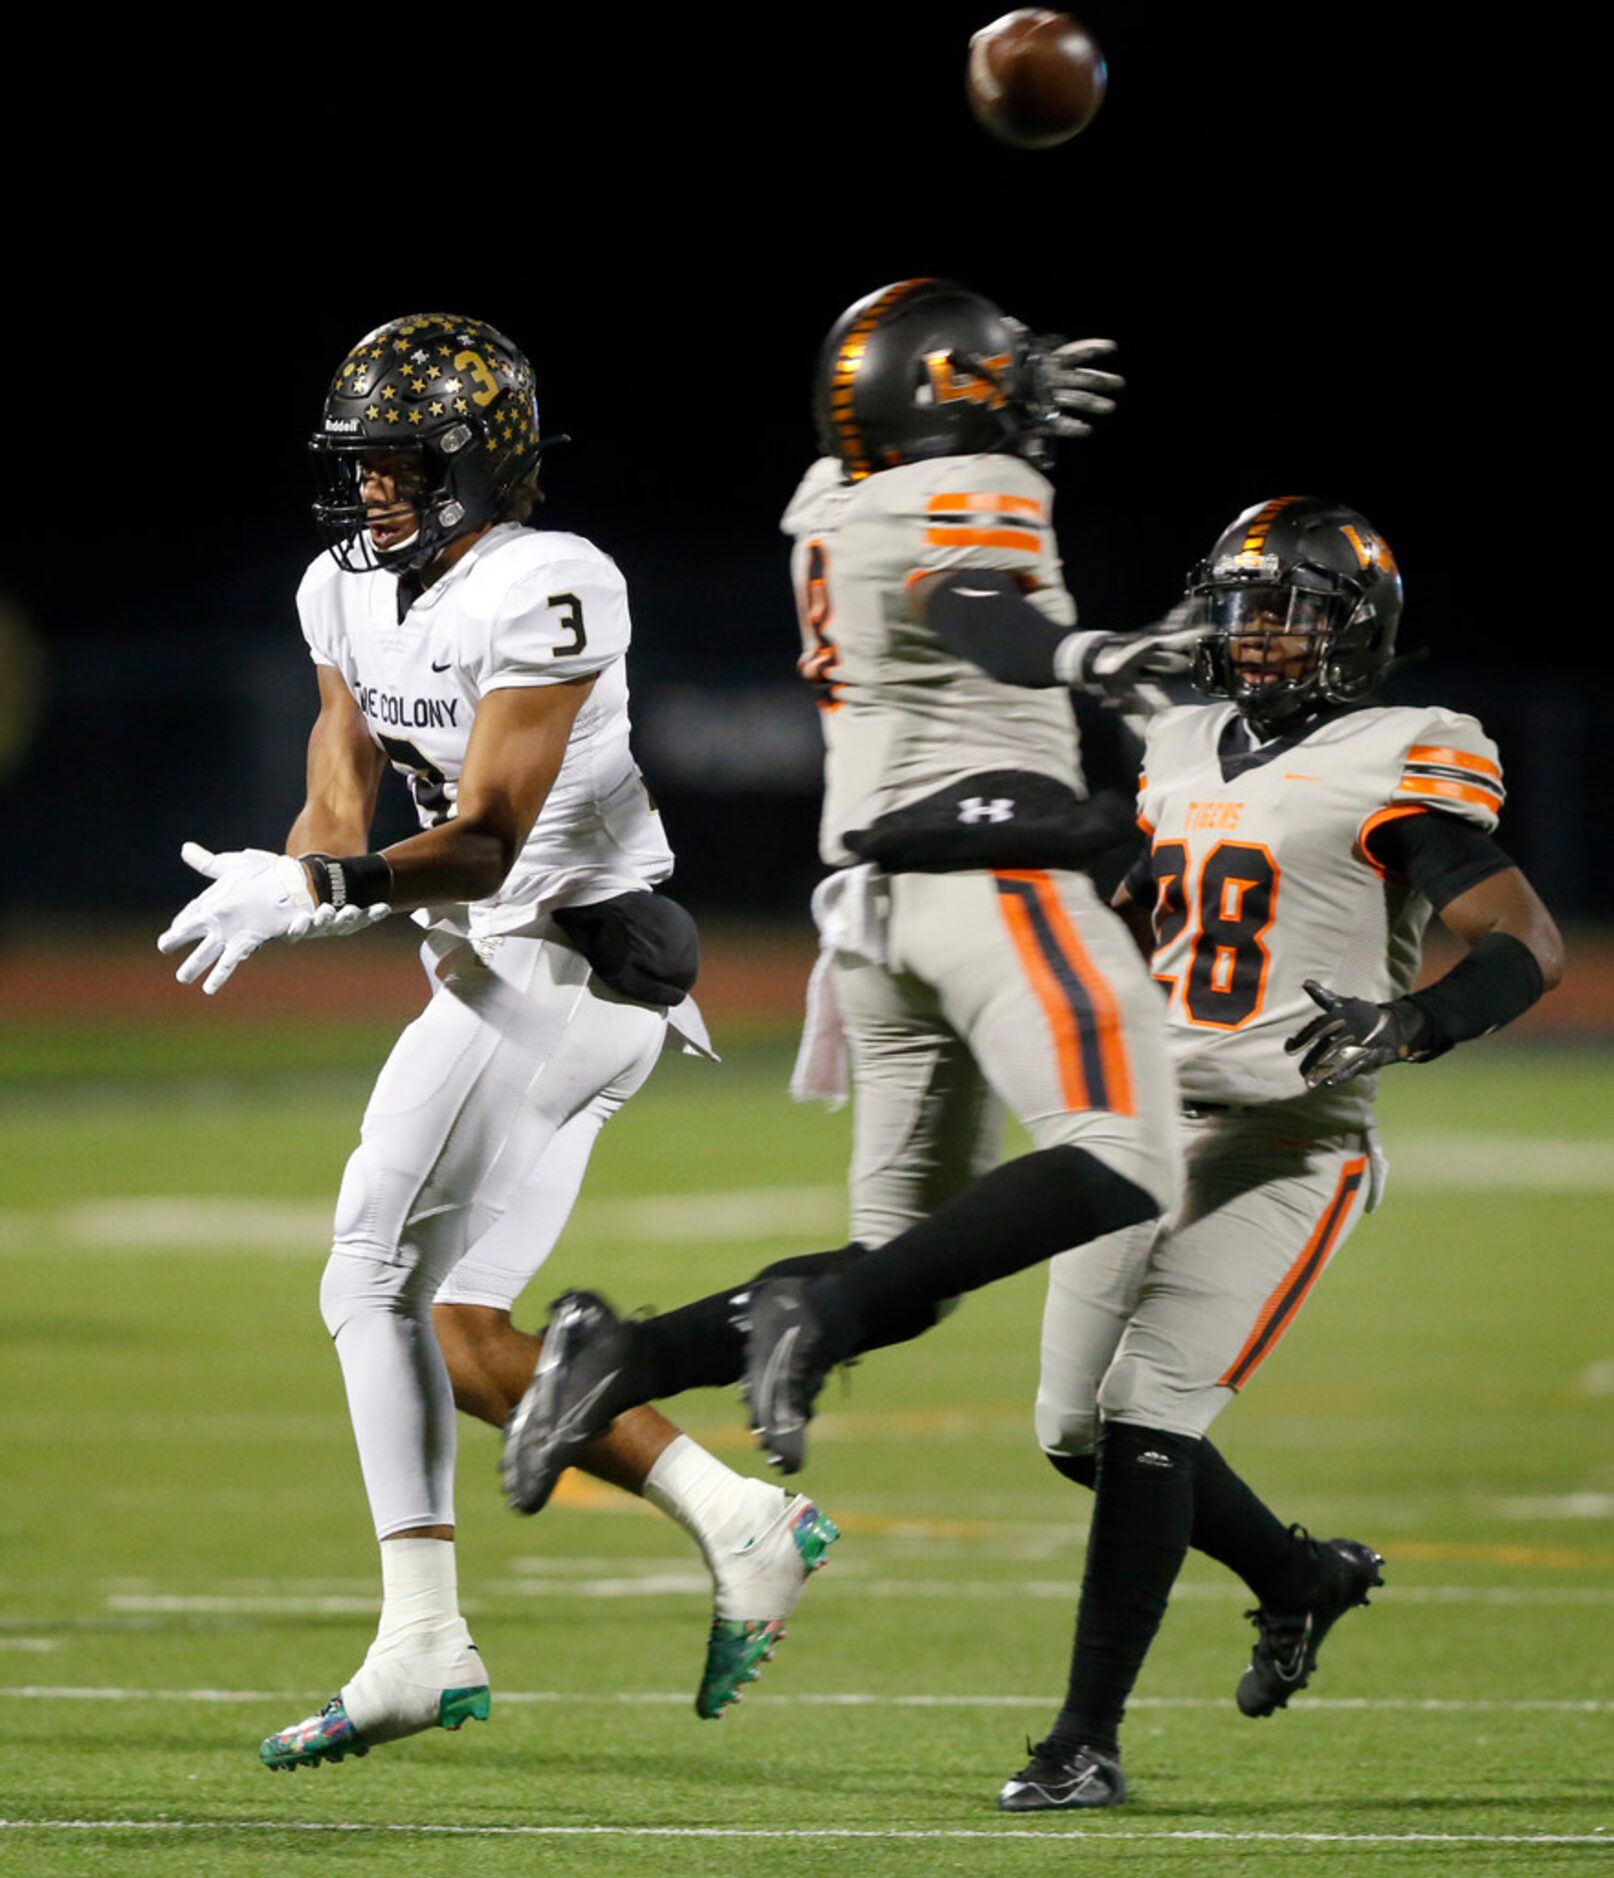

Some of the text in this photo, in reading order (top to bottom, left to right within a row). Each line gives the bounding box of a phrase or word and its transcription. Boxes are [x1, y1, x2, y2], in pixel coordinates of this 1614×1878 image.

[454, 350, 498, 407] 3
[548, 591, 587, 658] 3
[381, 694, 458, 728] COLONY
[1185, 802, 1245, 830] TIGERS
[327, 863, 347, 907] COLORADO
